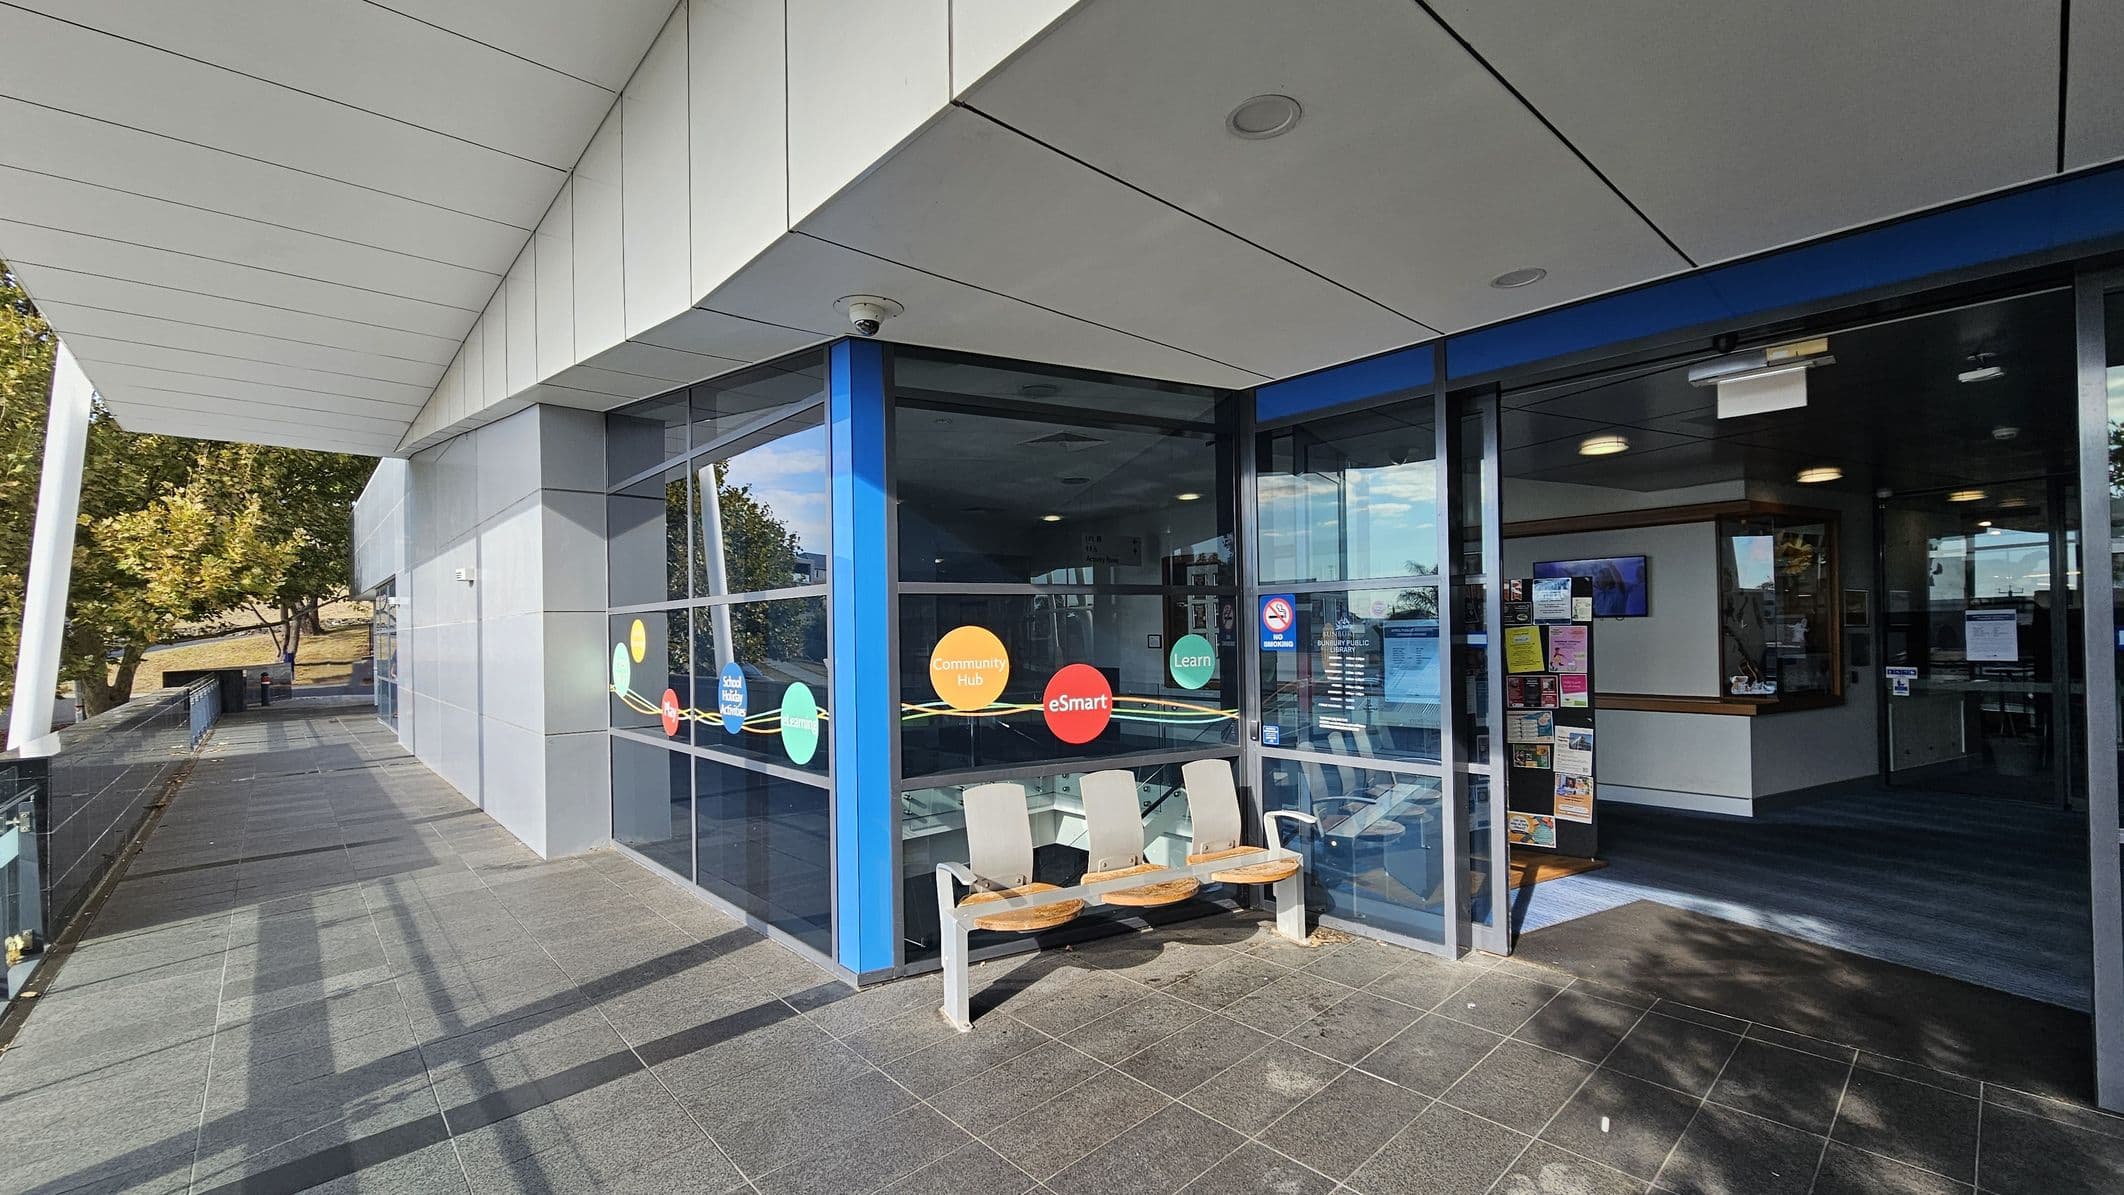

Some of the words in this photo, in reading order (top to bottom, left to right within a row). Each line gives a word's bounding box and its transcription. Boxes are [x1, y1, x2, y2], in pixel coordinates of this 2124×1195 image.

[1264, 640, 1294, 648] SMOKING
[1273, 633, 1283, 641] NO
[1317, 639, 1346, 647] BUNBURY
[1346, 639, 1370, 647] PUBLIC
[932, 656, 1008, 674] Community
[1174, 653, 1211, 668] Learn
[722, 675, 742, 689] School
[957, 673, 984, 687] Hub
[722, 689, 744, 705] Holiday
[1048, 693, 1108, 713] eSmart
[720, 703, 747, 718] Activities
[782, 713, 817, 735] eLearning
